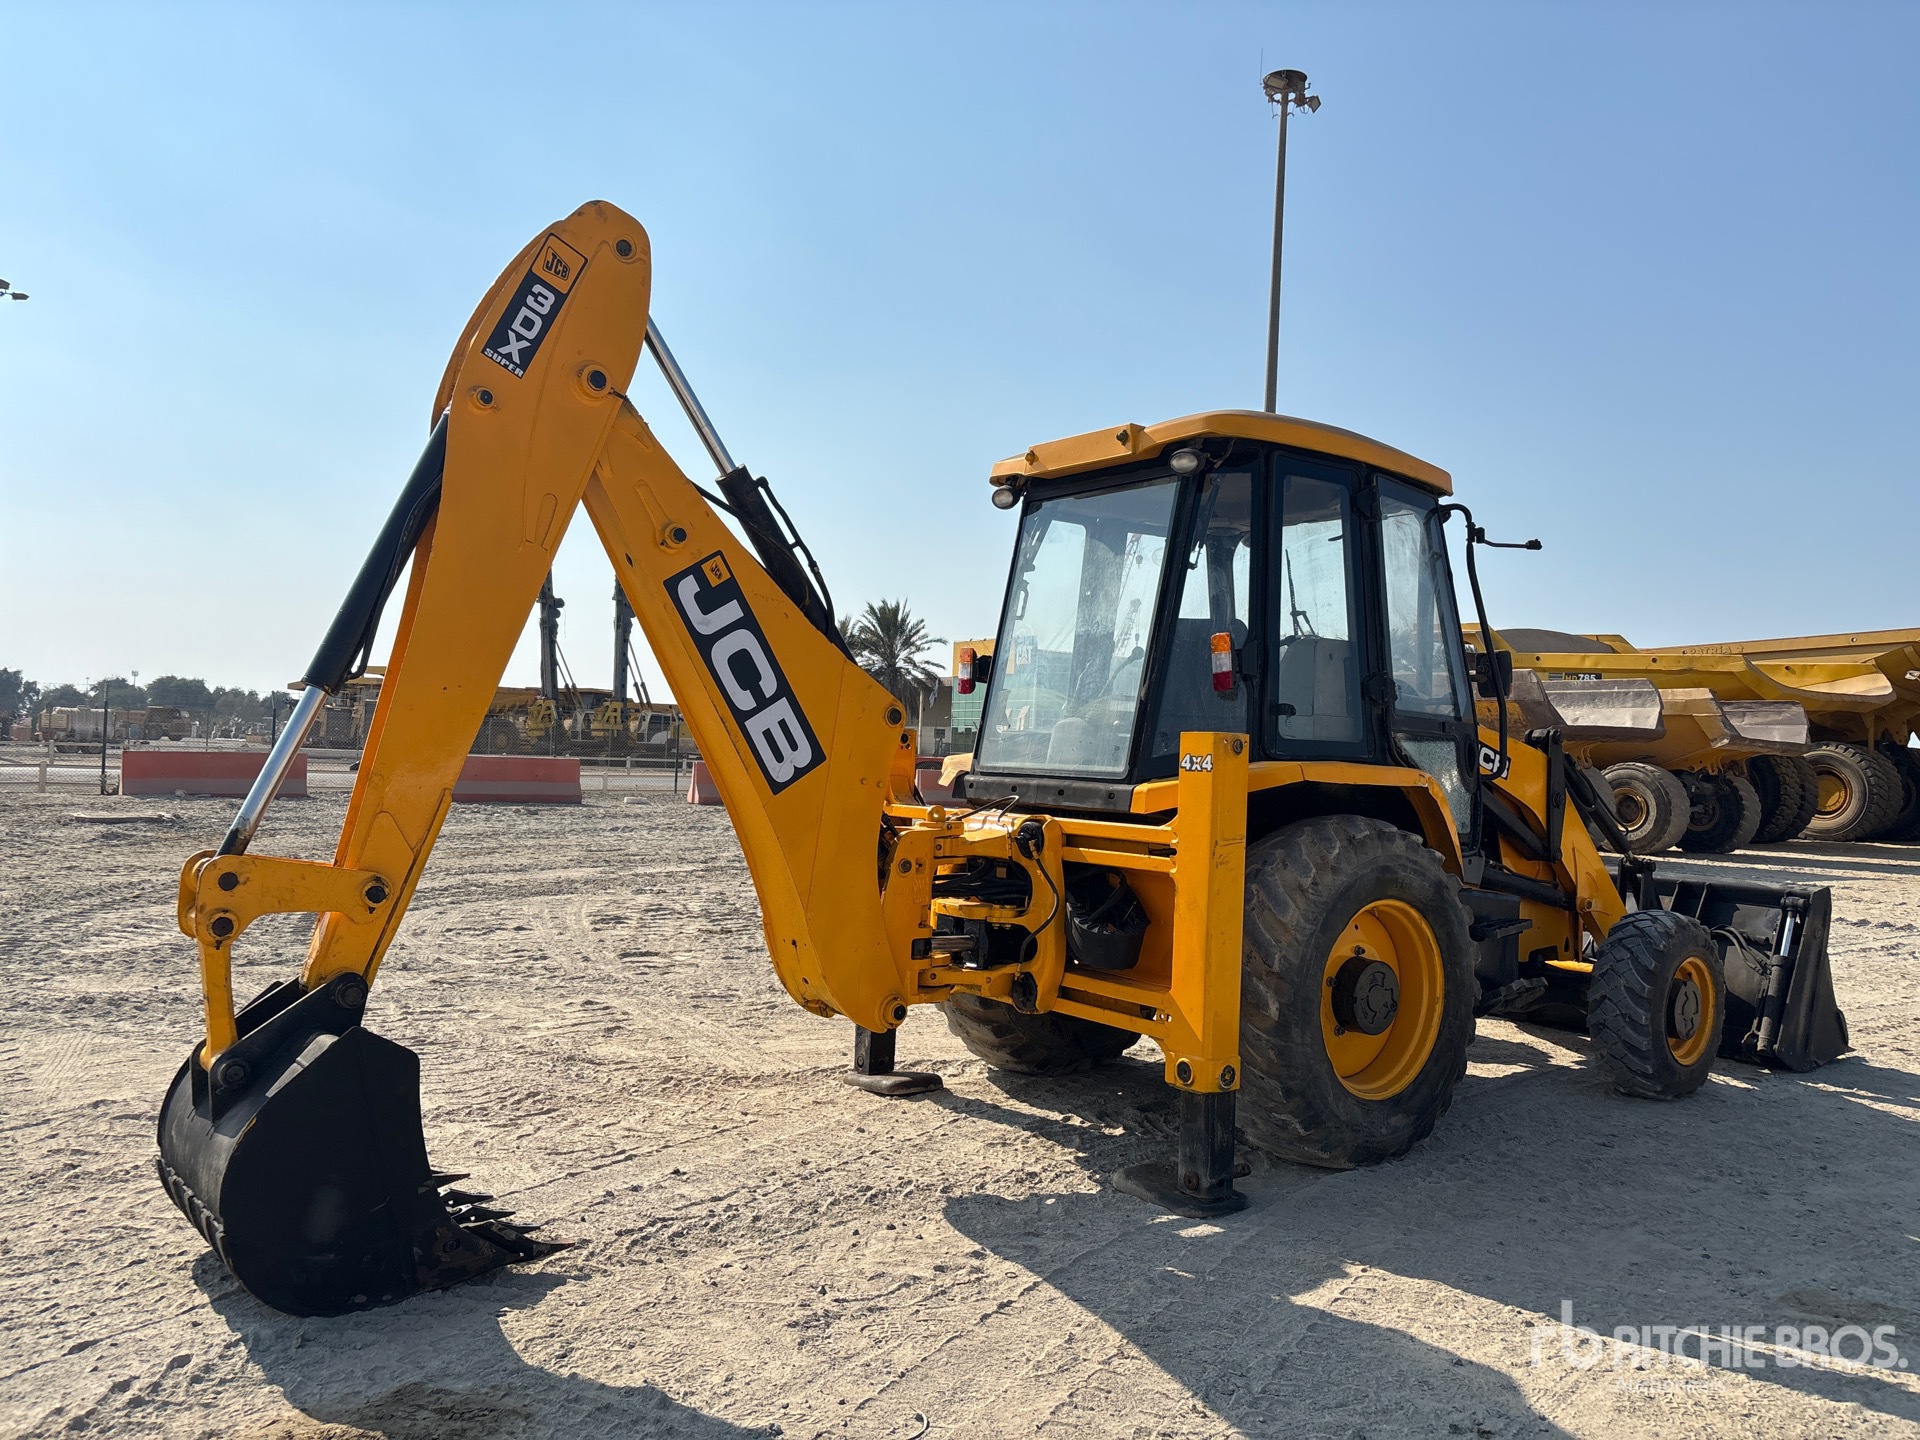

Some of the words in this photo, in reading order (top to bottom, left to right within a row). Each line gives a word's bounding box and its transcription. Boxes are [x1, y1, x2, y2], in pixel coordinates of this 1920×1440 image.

[545, 252, 568, 278] JCB
[497, 284, 555, 365] 3DX
[484, 348, 524, 378] SUPER
[677, 574, 812, 783] JCB
[1180, 753, 1213, 772] 4x4
